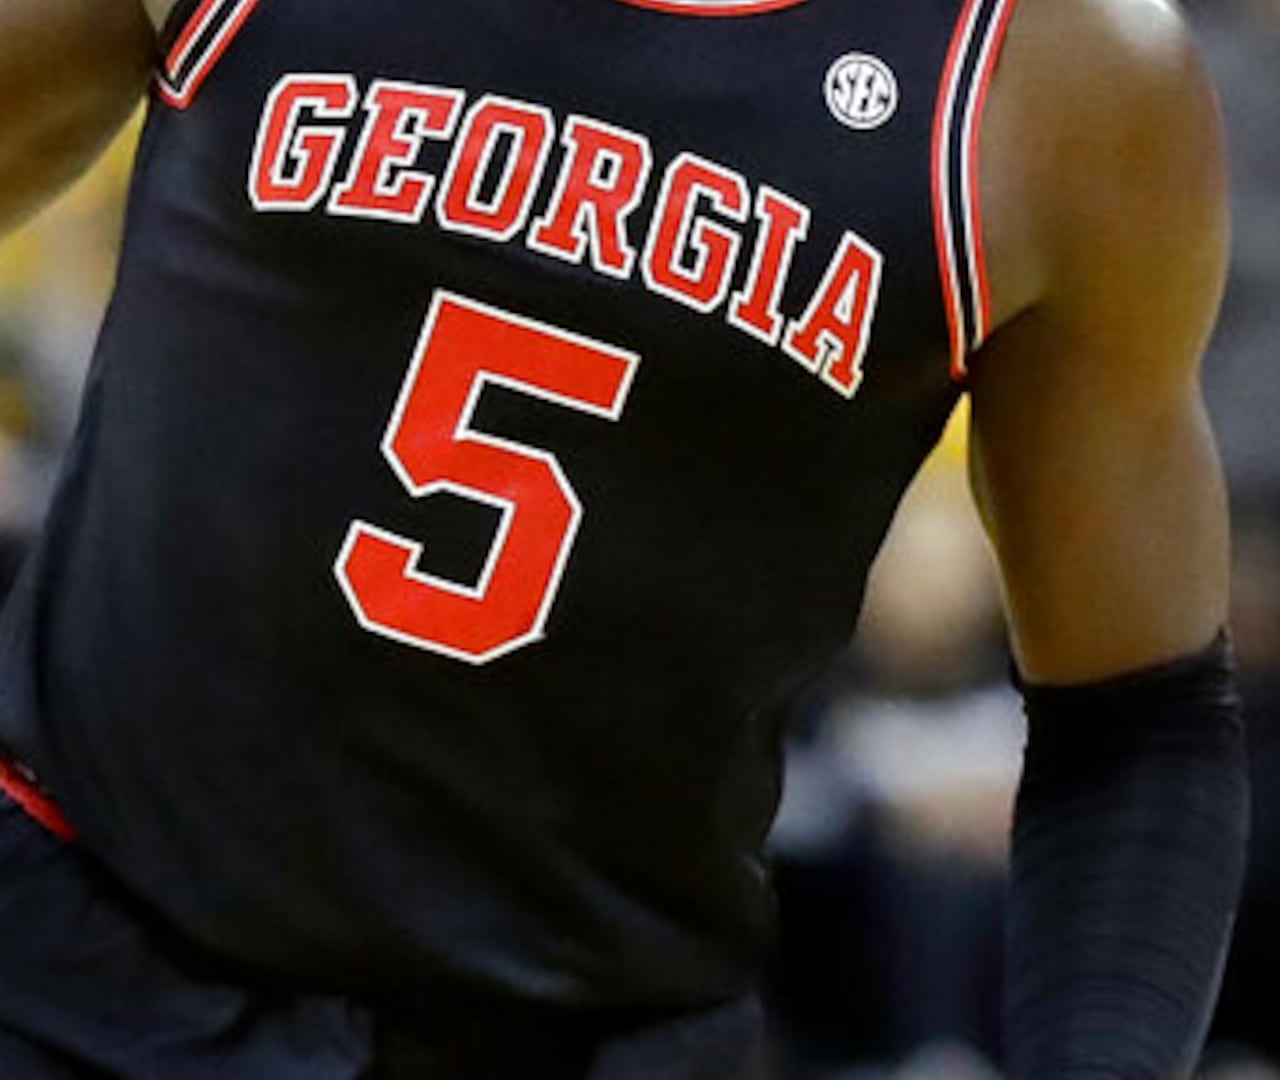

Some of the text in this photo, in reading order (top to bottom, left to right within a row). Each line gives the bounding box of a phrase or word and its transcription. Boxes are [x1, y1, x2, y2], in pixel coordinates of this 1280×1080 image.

[248, 73, 883, 399] GEORGIA
[832, 61, 890, 120] SEC
[333, 288, 641, 666] 5
